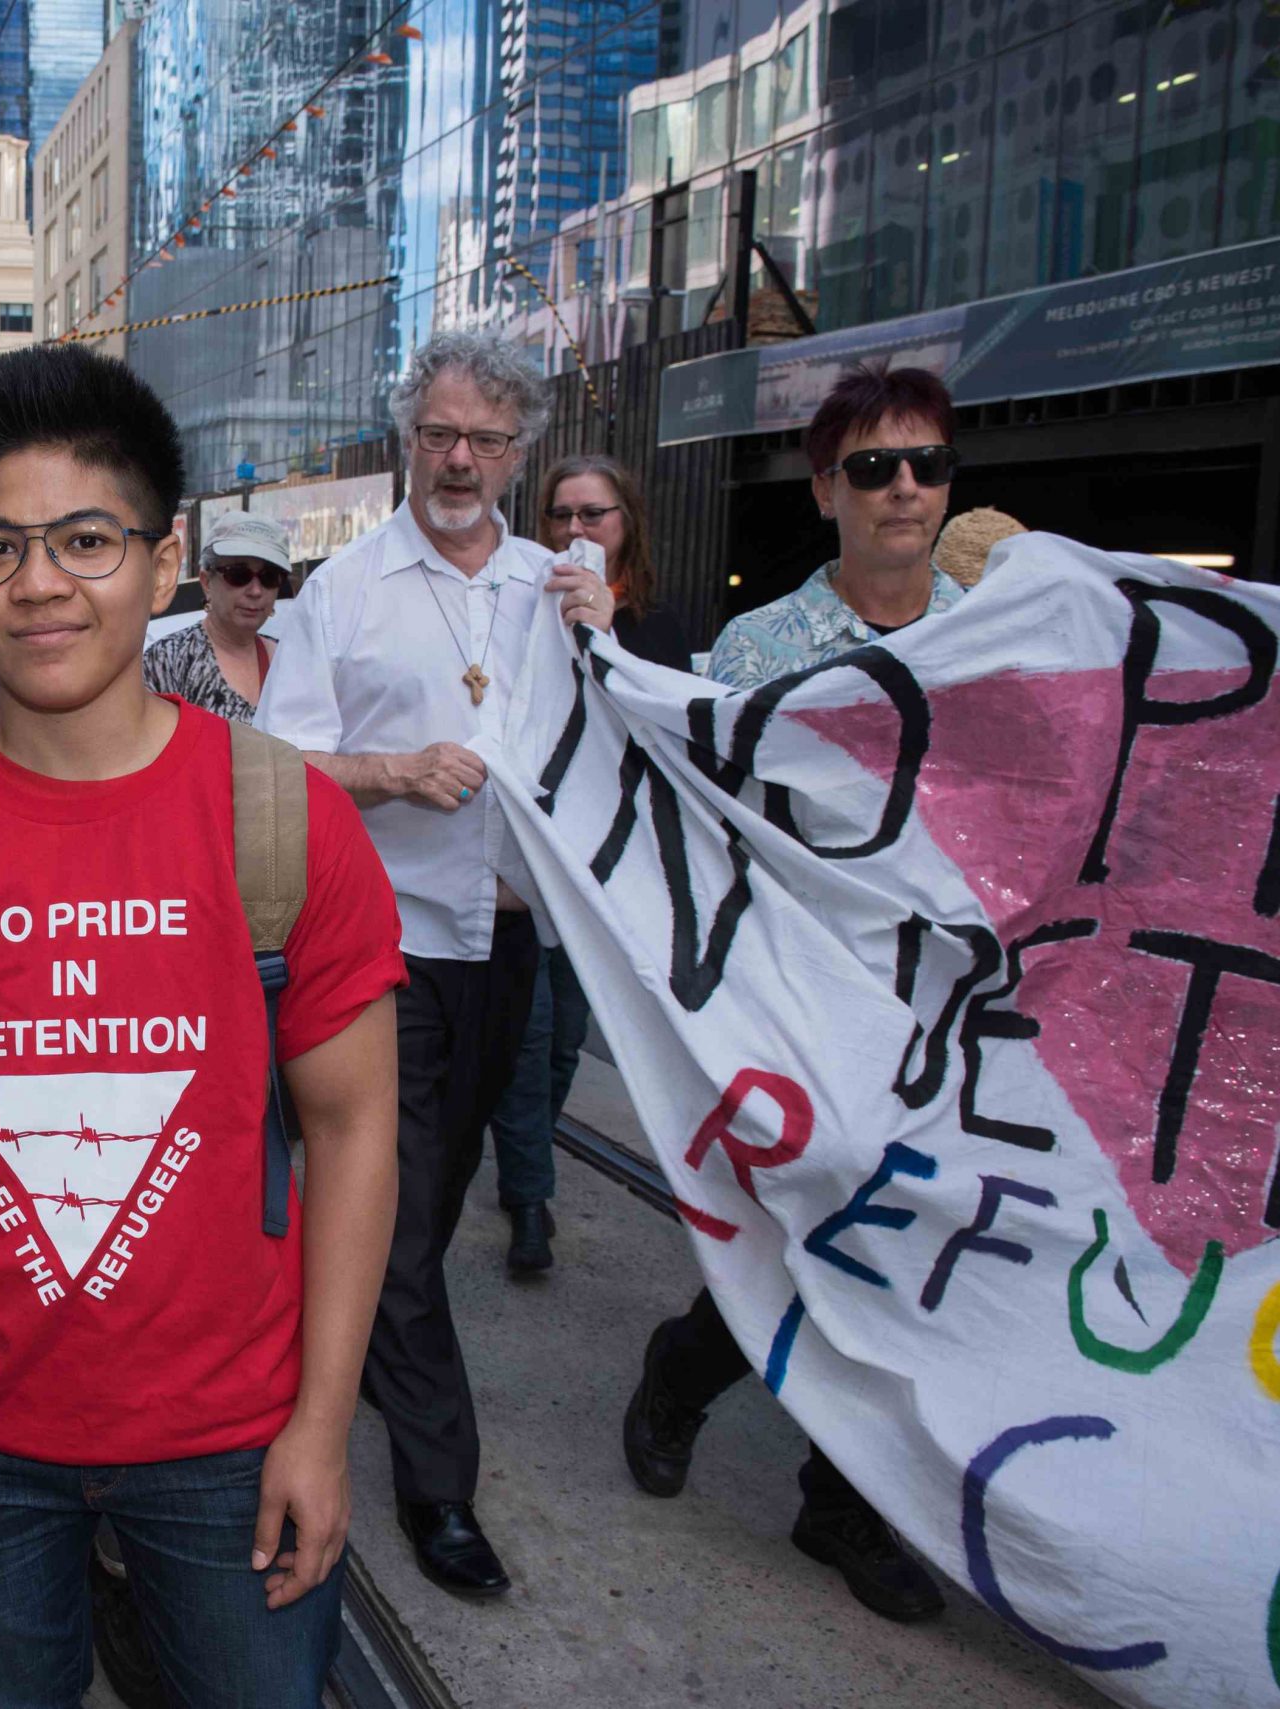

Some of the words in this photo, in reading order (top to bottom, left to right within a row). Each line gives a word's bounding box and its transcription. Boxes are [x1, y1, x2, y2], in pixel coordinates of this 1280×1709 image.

[1045, 291, 1139, 323] MELBOURNE
[1142, 278, 1193, 305] CBD'S
[1197, 264, 1276, 294] NEWEST
[1130, 310, 1186, 332] CONTACT
[1189, 305, 1218, 322] OUR
[1220, 298, 1263, 317] SALES
[48, 899, 188, 939] PRIDE
[52, 959, 97, 996] IN
[83, 1126, 202, 1301] REFUGEES
[14, 1234, 66, 1307] THE
